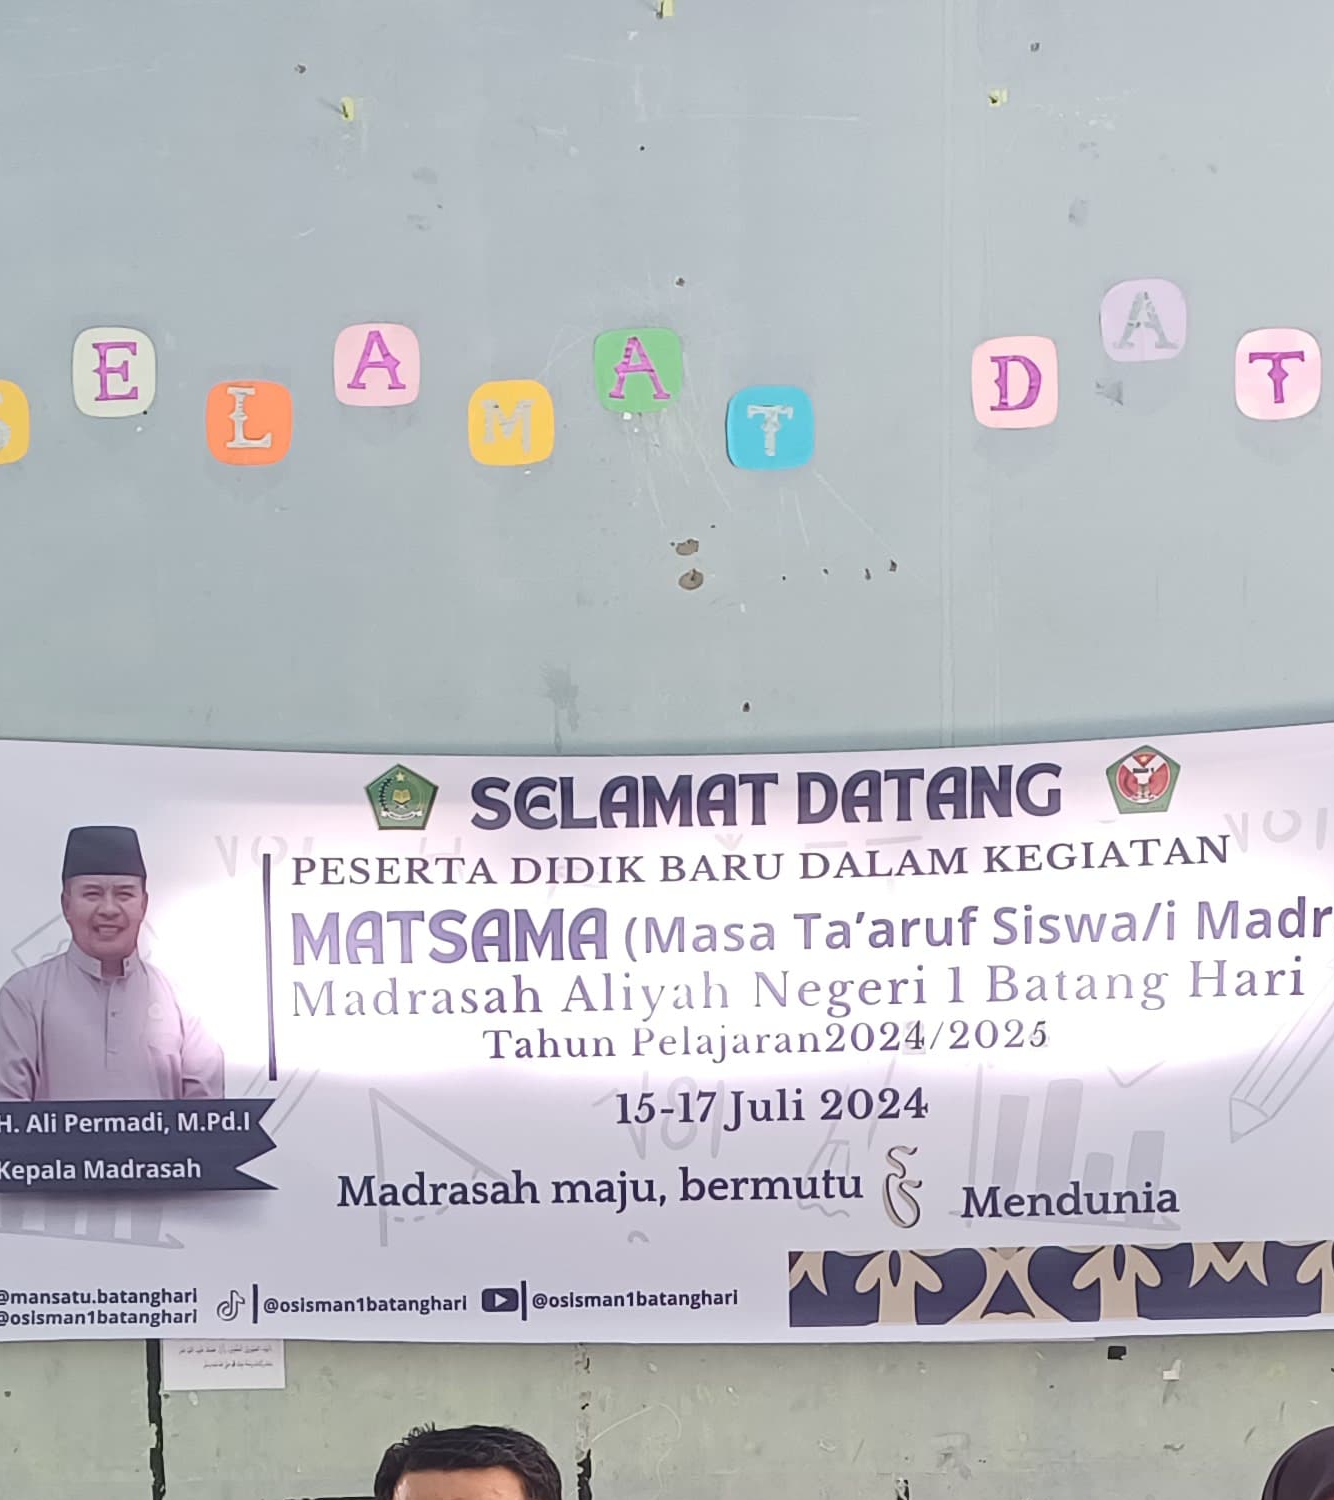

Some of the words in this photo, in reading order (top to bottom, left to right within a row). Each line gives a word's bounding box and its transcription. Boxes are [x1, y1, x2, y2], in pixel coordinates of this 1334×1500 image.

[470, 771, 779, 831] SELAMAT
[796, 762, 1063, 825] DATANG
[291, 855, 496, 886] PESERTA
[510, 855, 647, 885] DIDIK
[658, 852, 784, 882] BARU
[799, 846, 969, 880] DALAM
[982, 833, 1232, 874] KEGIATAN
[290, 906, 609, 966] MATSAMA
[624, 915, 776, 962] (Masa
[793, 906, 979, 951] Ta'aruf
[991, 899, 1177, 947] Siswa/i
[291, 974, 543, 1018] Madrasah
[560, 970, 730, 1023] Aliyah
[753, 965, 927, 1019] Negeri
[947, 965, 964, 1004] 1
[986, 963, 1170, 1011] Batang
[1187, 954, 1307, 999] Hari
[481, 1026, 617, 1060] Tahun
[632, 1020, 1048, 1063] Pelajaran2024/2025
[25, 1112, 58, 1134] Ali
[64, 1111, 170, 1136] Permadi,
[177, 1111, 251, 1132] M.Pd.I
[613, 1089, 718, 1126] 15-17
[722, 1086, 807, 1133] Juli
[818, 1086, 930, 1122] 2024
[82, 1158, 202, 1180] Madrasah
[337, 1168, 541, 1210] Madrasah
[550, 1172, 668, 1215] maju,
[677, 1165, 865, 1205] bermutu
[961, 1182, 1181, 1219] Mendunia
[263, 1294, 468, 1316] @osisman1batanghari
[531, 1288, 739, 1310] @osisman1batanghari
